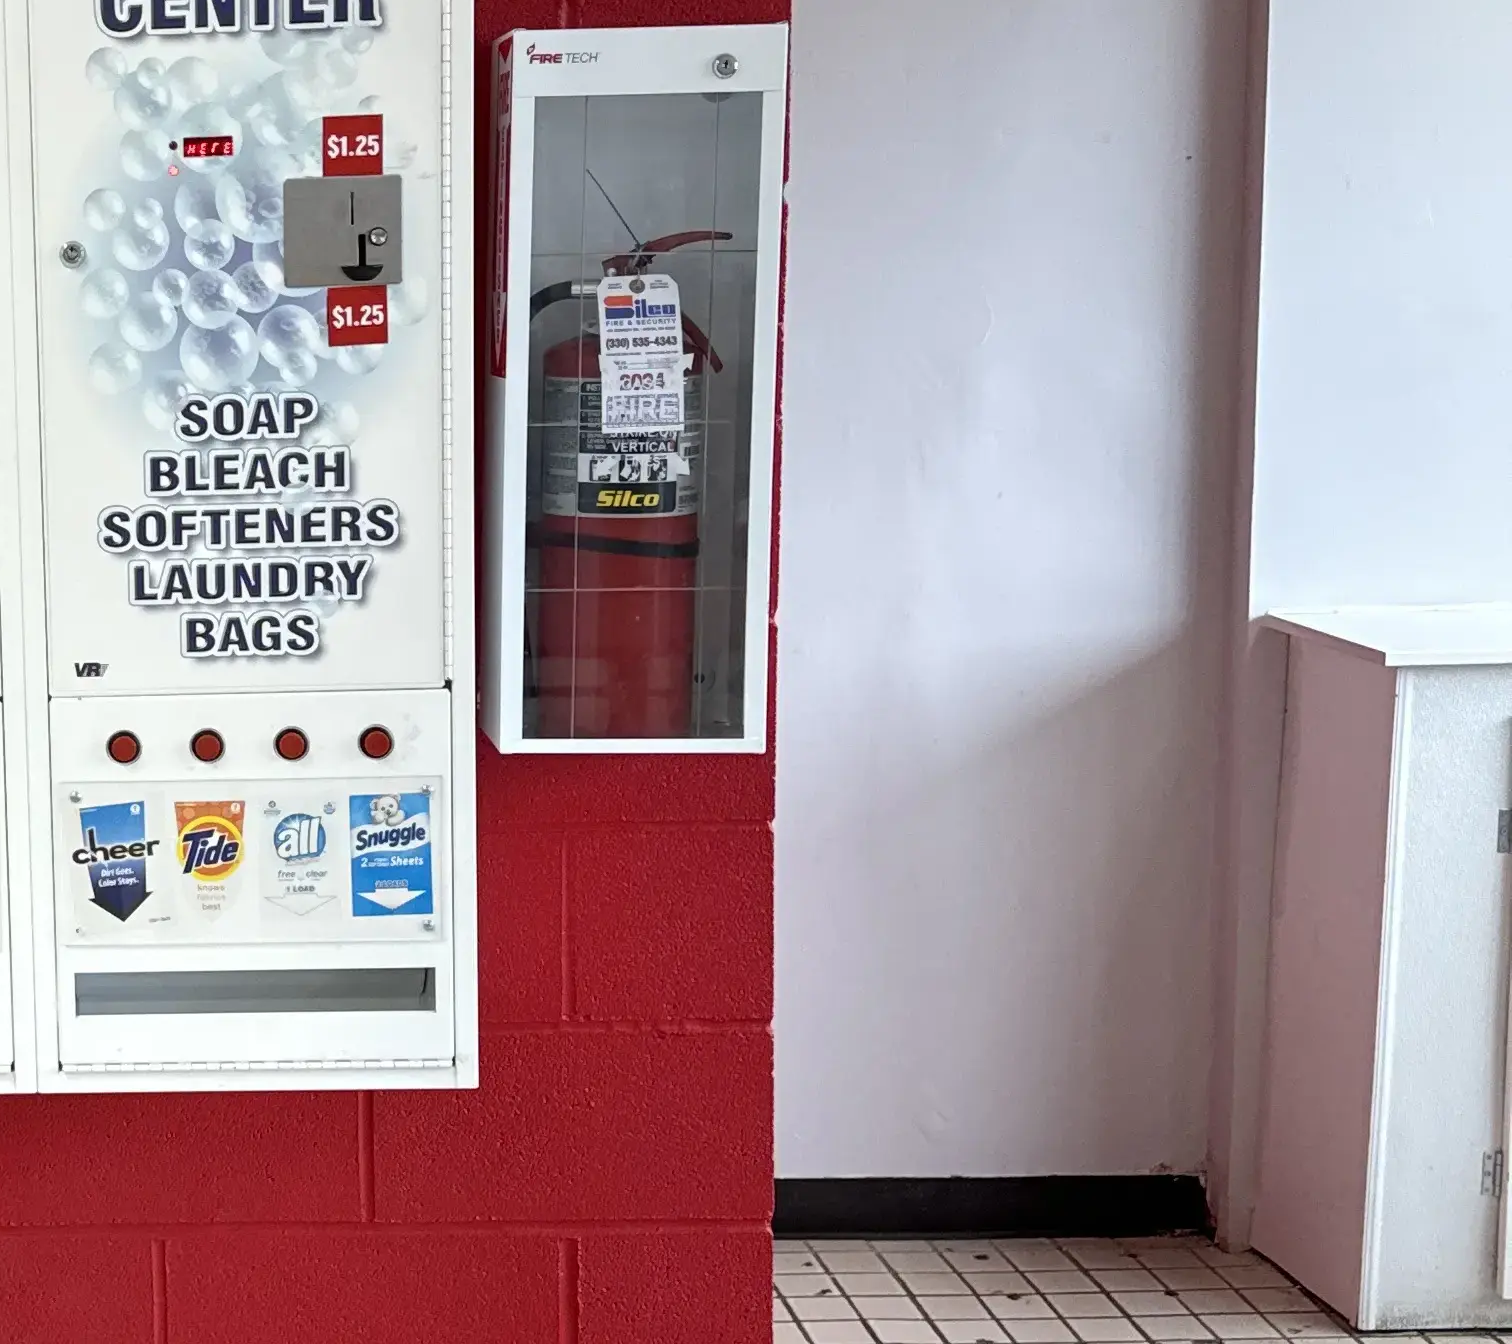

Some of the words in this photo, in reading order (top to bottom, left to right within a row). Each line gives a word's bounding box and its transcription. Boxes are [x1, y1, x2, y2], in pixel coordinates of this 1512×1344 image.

[529, 53, 563, 64] FIRE
[565, 52, 598, 64] TECH
[327, 135, 380, 159] $1.25
[332, 304, 385, 329] $1.25
[606, 319, 624, 327] FIRE
[636, 318, 677, 326] SECURITY
[606, 338, 630, 350] (330)
[179, 396, 315, 437] SOAP
[612, 441, 675, 453] VERTICAL
[148, 450, 346, 492] BLEACH
[595, 490, 661, 508] Silco
[102, 503, 396, 548] SOFTENERS
[132, 559, 369, 601] LAUNDRY
[185, 614, 316, 653] BAGS
[71, 828, 161, 865] cheer
[276, 816, 322, 860] all
[355, 822, 426, 851] Snuggle
[182, 828, 240, 874] Tide
[390, 855, 424, 867] Sheets
[277, 869, 296, 879] free
[305, 869, 328, 878] clear
[202, 902, 221, 910] best
